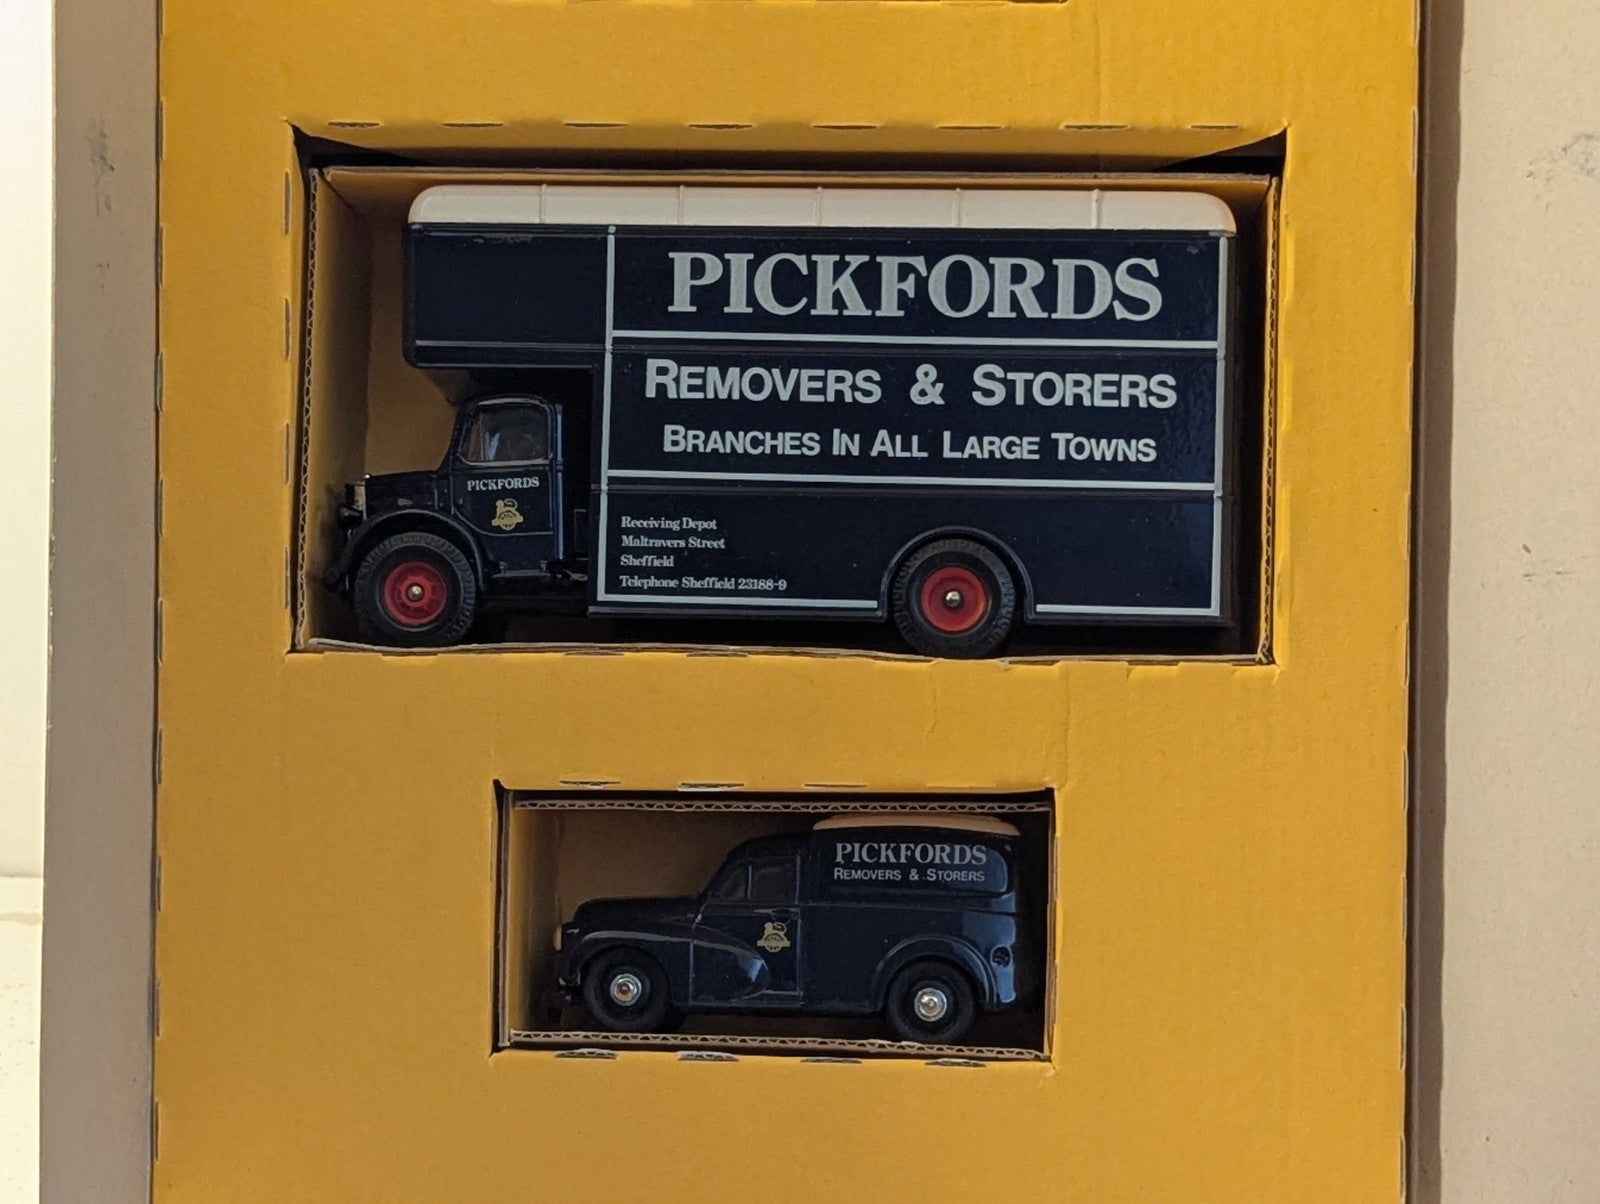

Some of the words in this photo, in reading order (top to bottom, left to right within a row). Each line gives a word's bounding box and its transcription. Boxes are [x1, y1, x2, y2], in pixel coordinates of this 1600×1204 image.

[667, 251, 1163, 321] PICKFORDS
[645, 358, 882, 403] REMOVERS
[909, 364, 945, 406] &
[971, 364, 1178, 409] STORERS
[663, 424, 820, 456] BRANCHES
[870, 429, 928, 458] ALL
[942, 430, 1040, 460] LARGE
[1052, 432, 1157, 462] TOWNS
[467, 476, 540, 491] PICKFORDS
[621, 516, 680, 531] Receiving
[682, 517, 717, 531] Depot
[621, 535, 686, 548] Maltravers
[688, 537, 725, 549] Street
[620, 554, 674, 567] Sheffield
[619, 575, 679, 589] Telephone
[681, 577, 735, 589] Sheffield
[738, 578, 787, 590] 23188-9
[835, 843, 987, 865] PICKFORDS
[833, 867, 901, 881] REMOVERS
[909, 868, 919, 881] &
[926, 869, 985, 882] STORERS
